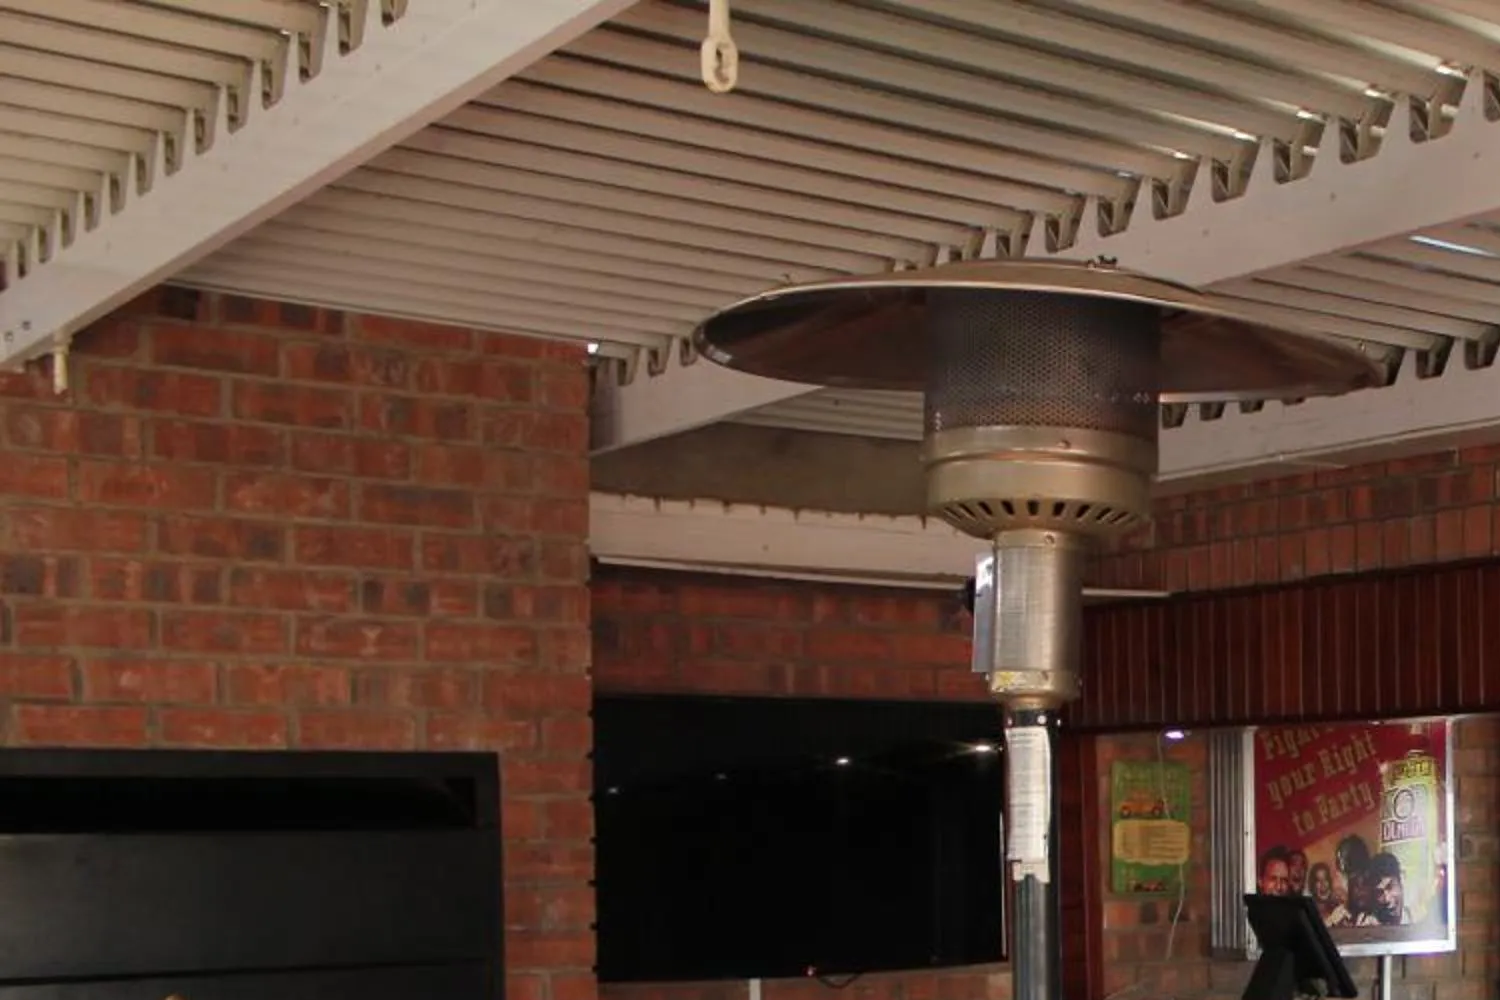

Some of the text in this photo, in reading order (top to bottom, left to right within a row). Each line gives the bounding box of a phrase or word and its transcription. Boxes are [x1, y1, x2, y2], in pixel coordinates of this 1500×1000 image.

[1266, 762, 1316, 810] your
[1317, 729, 1376, 779] Right
[1291, 782, 1376, 837] to Party
